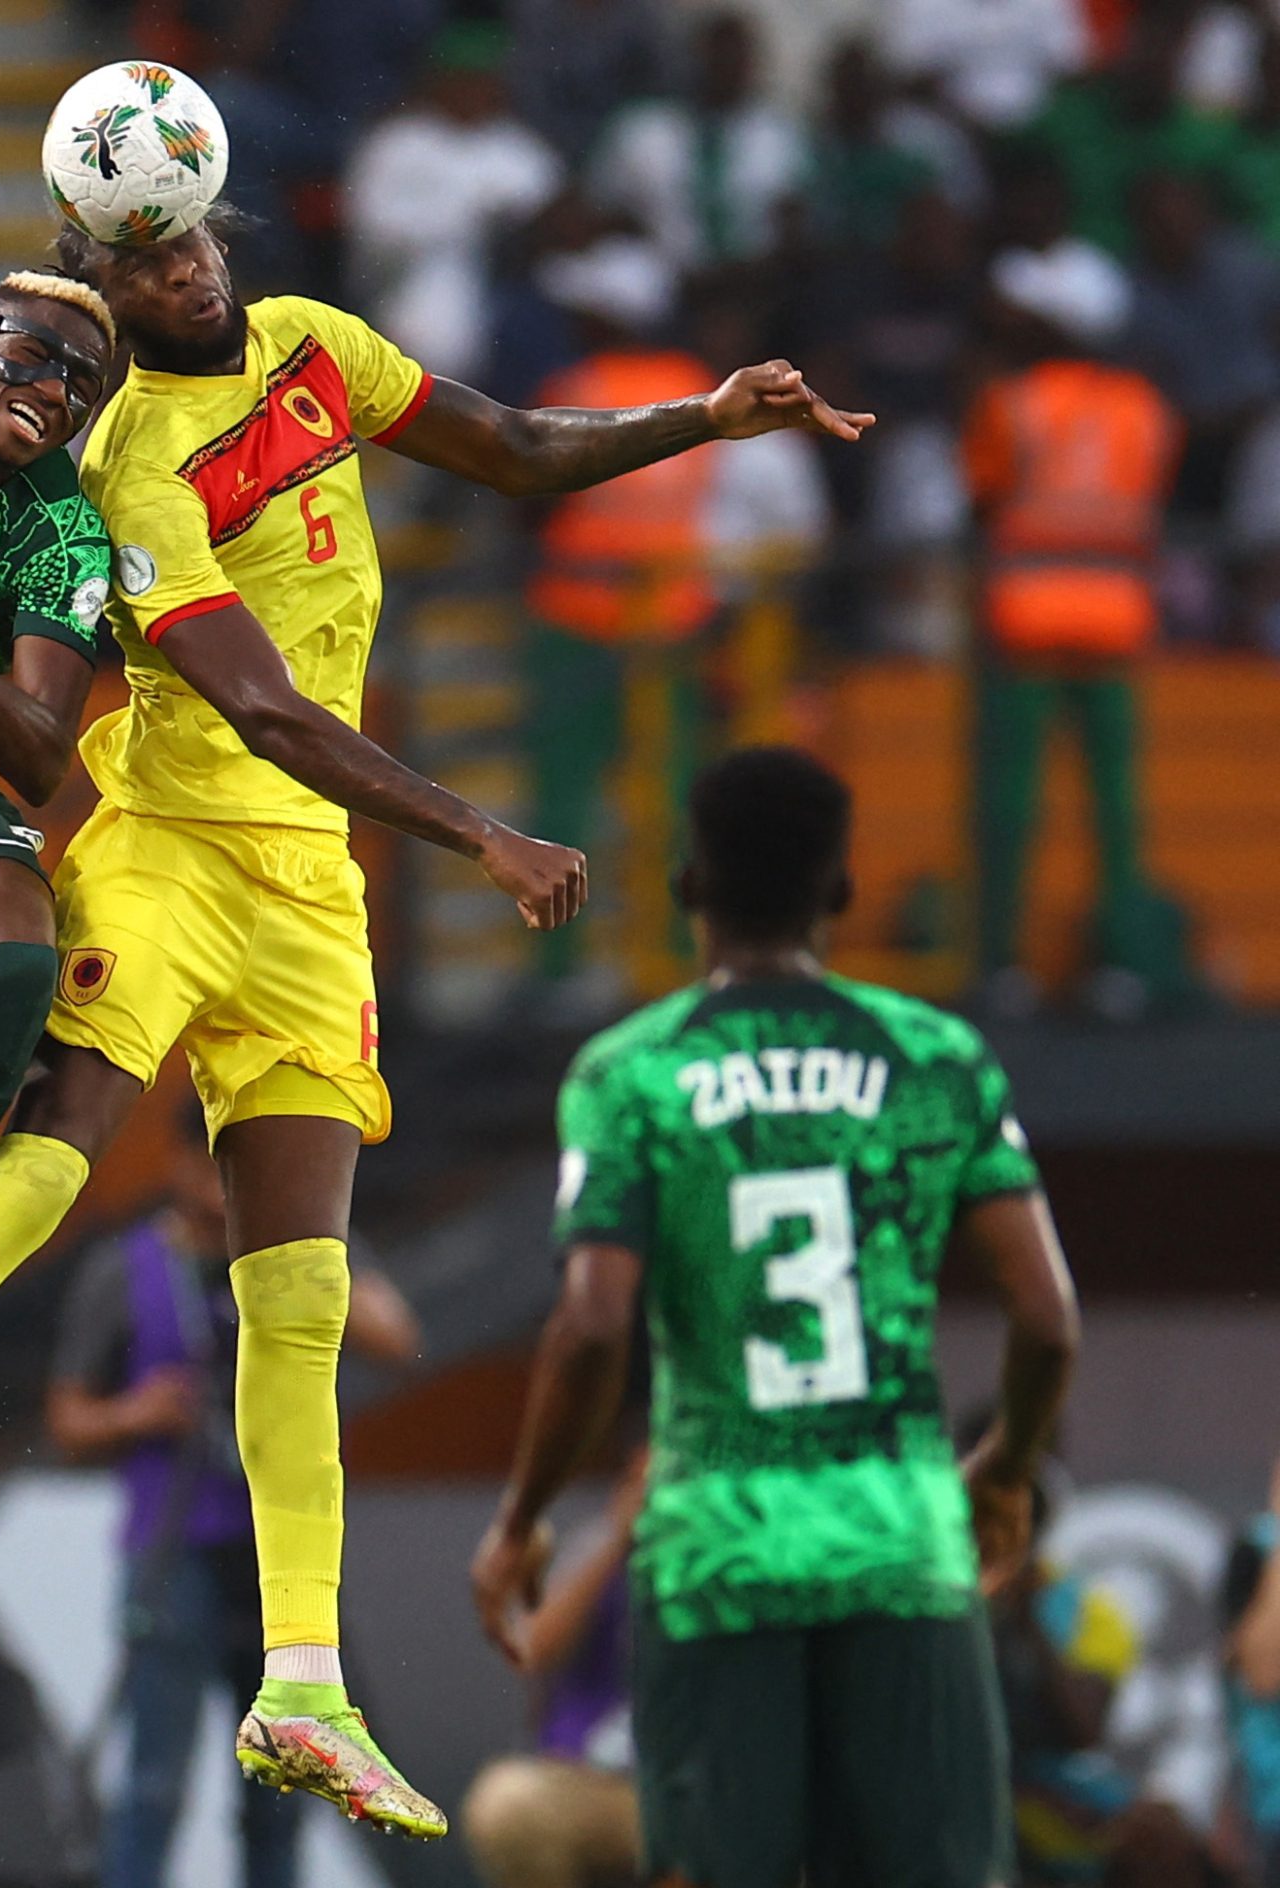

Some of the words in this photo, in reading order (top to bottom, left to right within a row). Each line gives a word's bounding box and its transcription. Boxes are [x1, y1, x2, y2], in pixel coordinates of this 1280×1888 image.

[300, 485, 338, 564] 6
[675, 1047, 889, 1128] ZAIDU
[729, 1166, 869, 1411] 3
